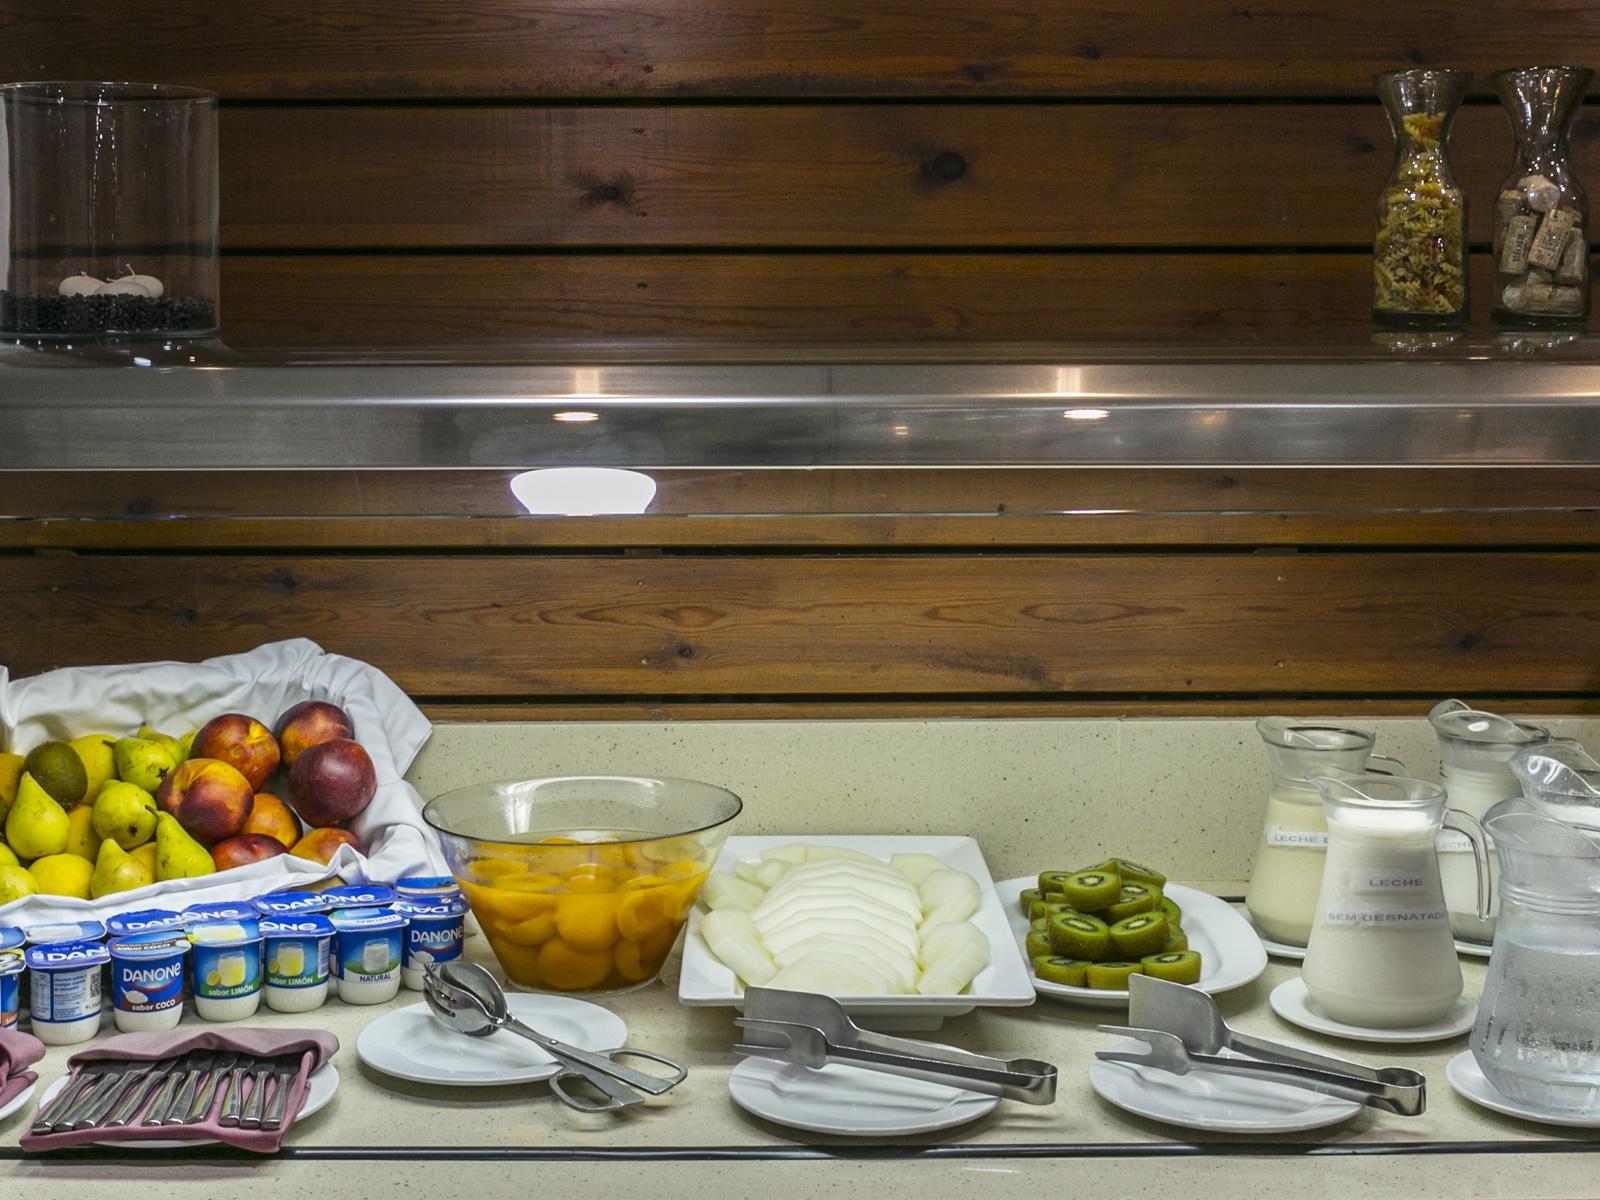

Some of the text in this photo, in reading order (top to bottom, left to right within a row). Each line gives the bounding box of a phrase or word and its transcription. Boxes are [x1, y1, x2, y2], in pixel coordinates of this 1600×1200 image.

[1273, 835, 1319, 843] LECHE
[1369, 878, 1424, 888] LECHE
[269, 976, 313, 986] sabor LIMÓN
[359, 974, 391, 983] NATURAL
[208, 984, 254, 997] sabor LIMÓN
[131, 1003, 154, 1012] sabor
